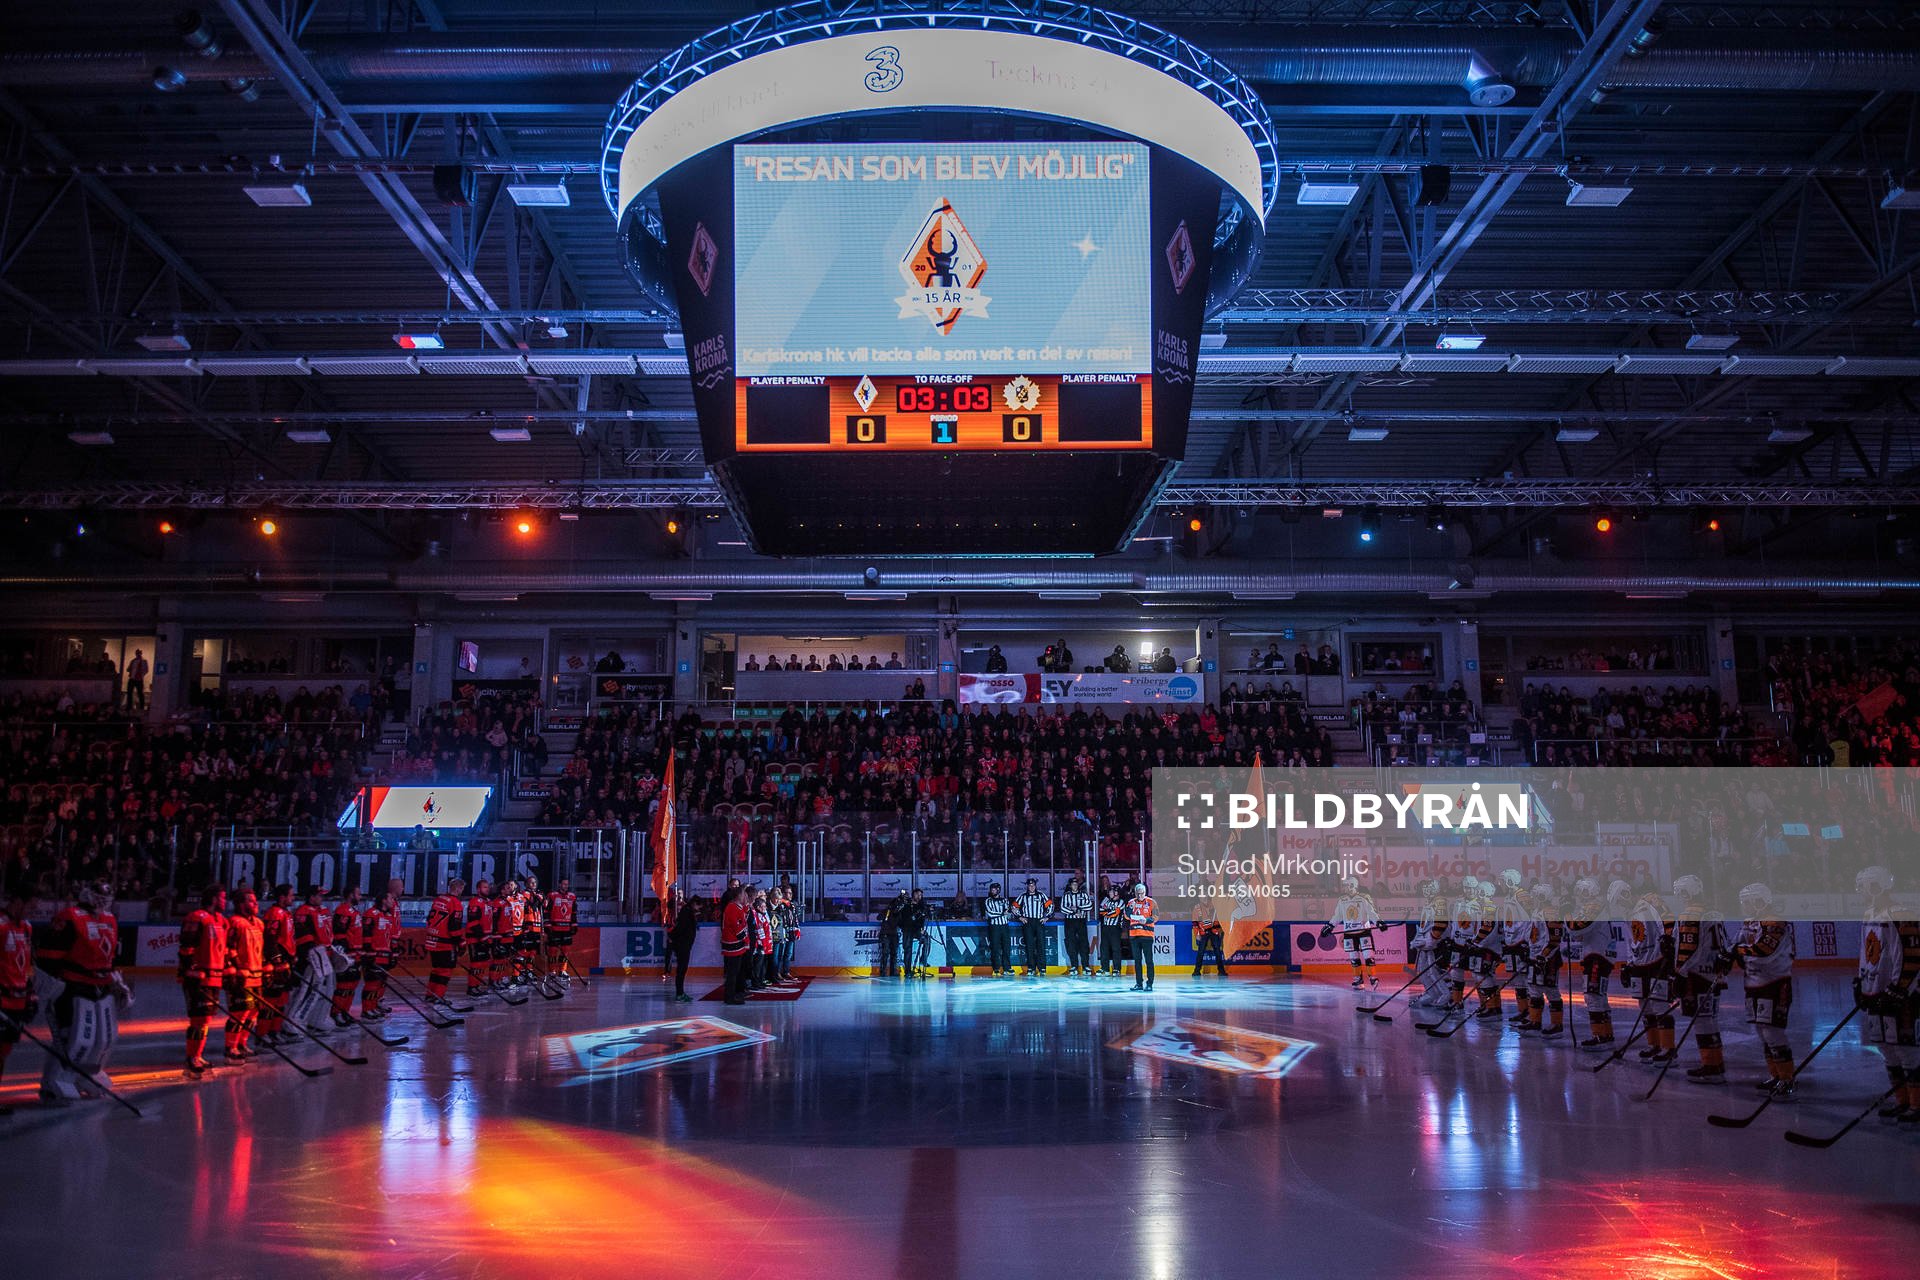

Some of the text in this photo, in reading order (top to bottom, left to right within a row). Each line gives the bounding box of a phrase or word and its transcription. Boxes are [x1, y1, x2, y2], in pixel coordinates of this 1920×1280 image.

[864, 45, 904, 93] 3
[744, 148, 1134, 182] "RESAN SOM BLEV MÖJLIG"
[925, 293, 939, 303] 15
[943, 290, 961, 303] ÅR
[693, 334, 725, 359] KARLS
[1158, 329, 1188, 354] KARLS
[695, 349, 728, 373] KRONA
[826, 347, 845, 361] hk
[871, 348, 912, 361] tacka
[944, 348, 976, 360] som
[1018, 348, 1036, 360] en
[1157, 344, 1189, 370] KRONA
[751, 377, 825, 385] PLAYER PENALTY
[915, 375, 973, 383] TO FACE-OFF
[1063, 374, 1137, 383] PLAYER PENALTY
[899, 387, 989, 411] 03:03
[856, 418, 875, 441] 0
[937, 423, 952, 443] 1
[1012, 417, 1031, 441] 0
[1046, 680, 1073, 697] EY
[1130, 676, 1168, 687] Fribergs
